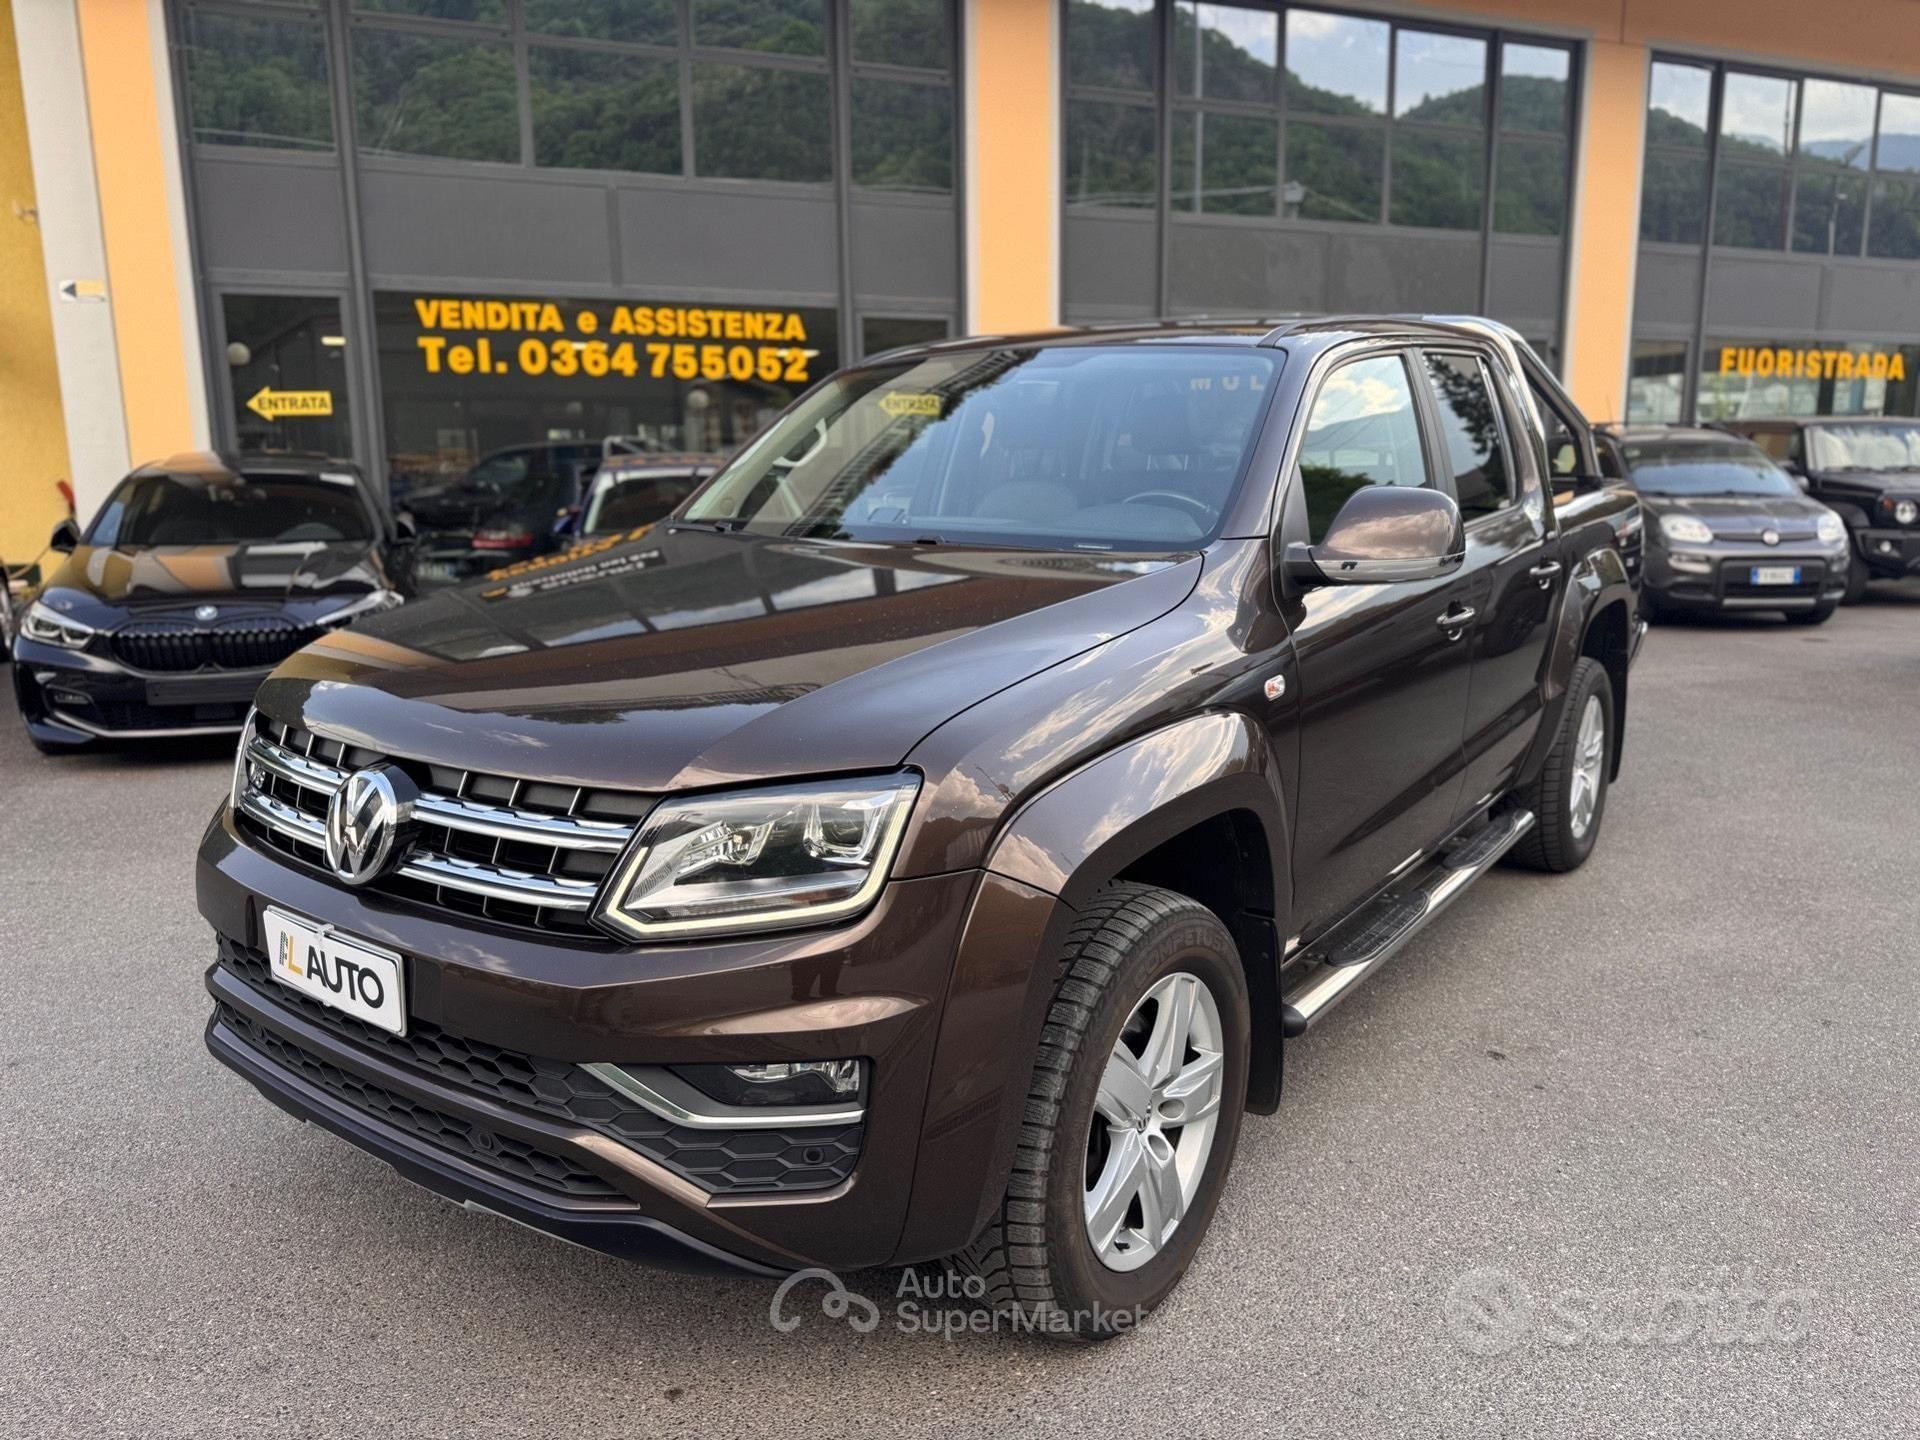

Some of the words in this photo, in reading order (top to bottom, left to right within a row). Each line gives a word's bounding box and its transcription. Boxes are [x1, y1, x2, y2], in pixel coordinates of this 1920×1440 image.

[415, 299, 564, 332] VENDITA
[576, 310, 597, 333] e
[610, 306, 806, 341] ASSISTENZA
[417, 336, 508, 374] Tel.
[518, 339, 637, 377] 0364
[646, 344, 808, 382] 755052
[1719, 347, 1905, 380] FUORISTRADA
[258, 397, 329, 410] ENTRATA
